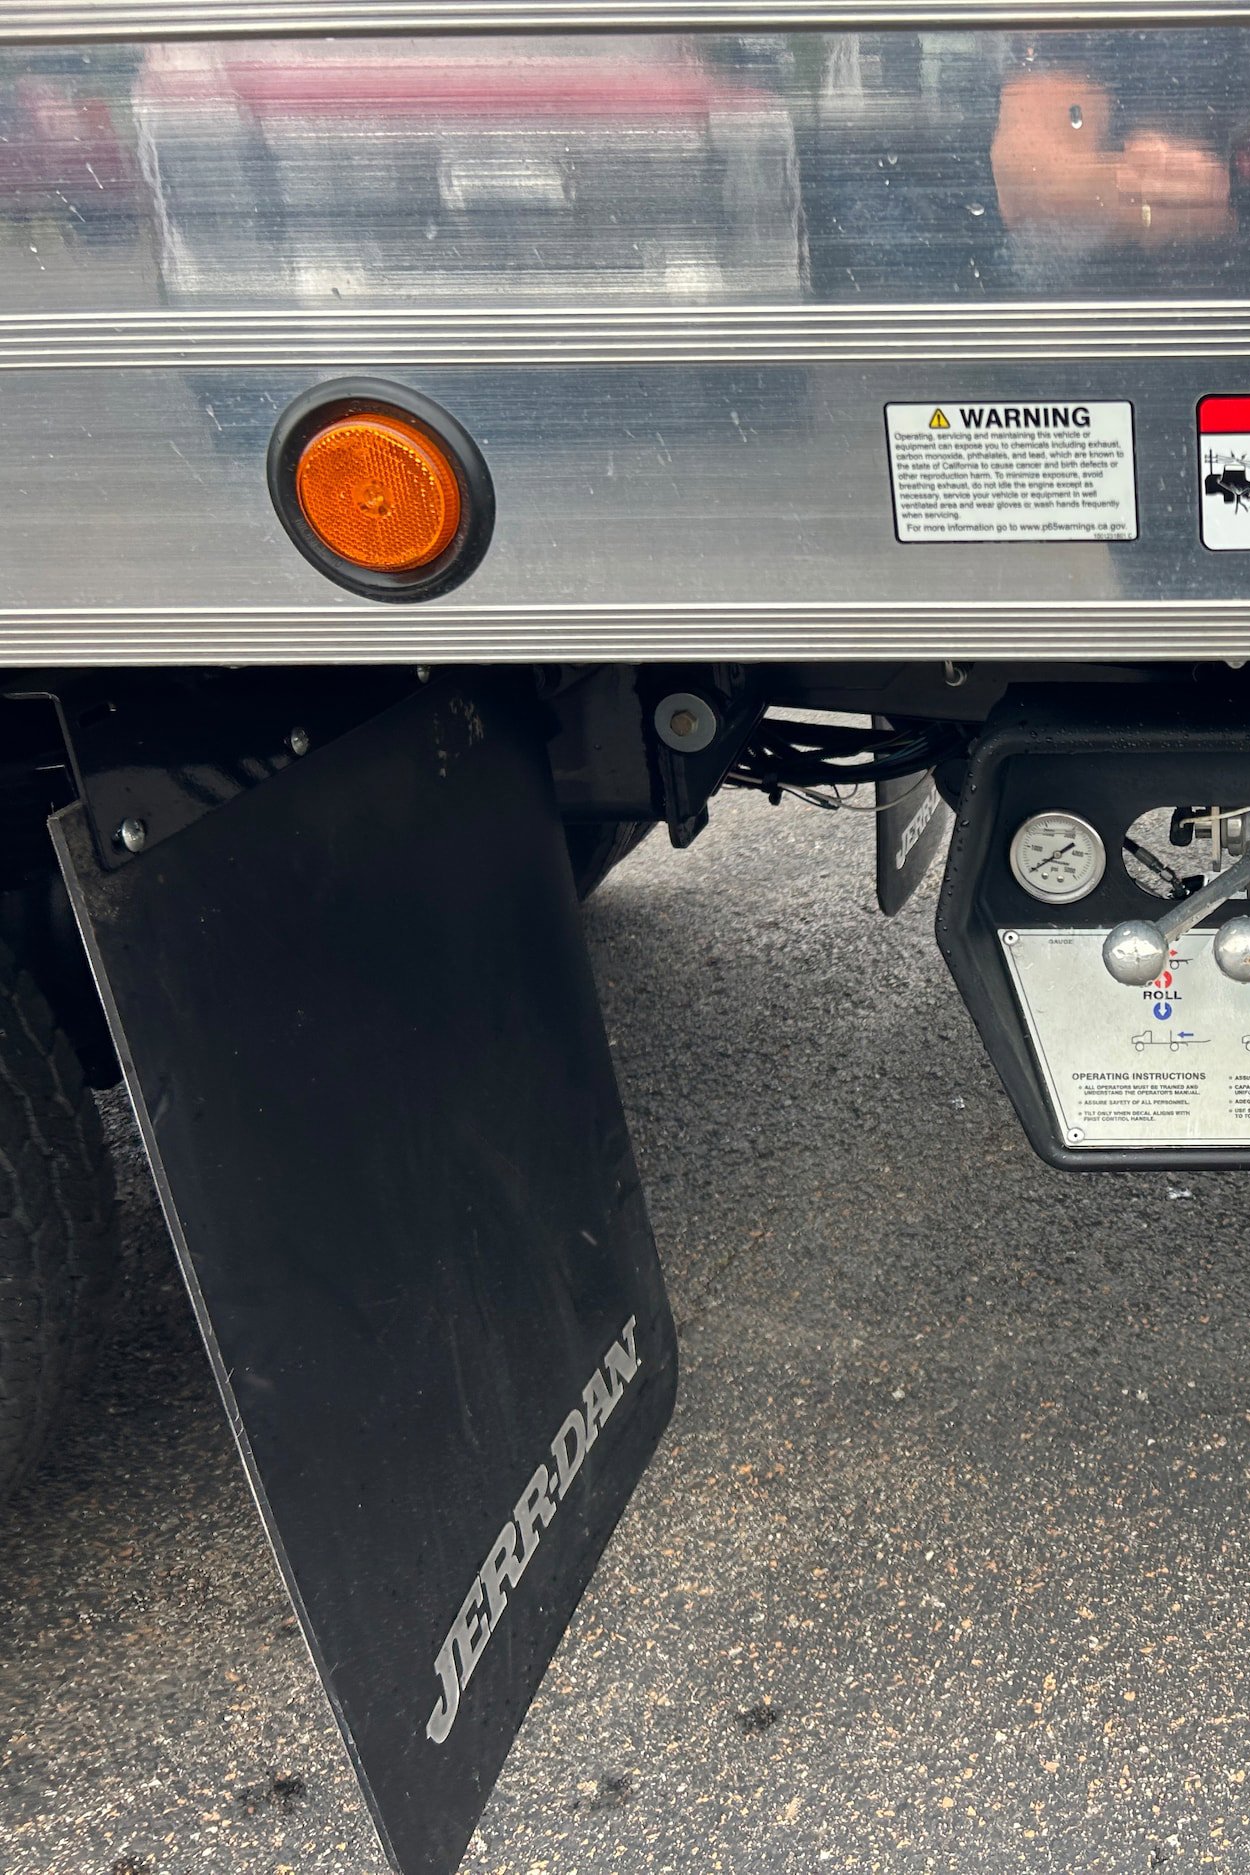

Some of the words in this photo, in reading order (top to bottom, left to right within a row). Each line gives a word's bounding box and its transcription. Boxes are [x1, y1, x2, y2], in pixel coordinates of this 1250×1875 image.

[960, 407, 1091, 428] WARNING
[894, 432, 935, 442] Operating,
[937, 432, 972, 442] servicing
[973, 432, 989, 440] and
[990, 431, 1036, 441] maintaining
[1036, 431, 1051, 439] this
[1053, 431, 1081, 439] vehicle
[895, 442, 936, 452] equipment
[954, 443, 983, 451] expose
[984, 443, 999, 451] you
[1001, 441, 1009, 449] to
[1010, 441, 1050, 449] chemicals
[1051, 441, 1087, 451] including
[1088, 441, 1121, 451] exhaust,
[897, 462, 910, 470] the
[911, 462, 931, 470] state
[942, 461, 979, 469] California
[981, 461, 989, 469] to
[1044, 461, 1059, 469] and
[1080, 460, 1108, 468] defects
[920, 471, 968, 481] reproduction
[970, 471, 992, 479] harm.
[994, 471, 1005, 479] To
[1006, 471, 1040, 479] minimize
[1042, 472, 1080, 480] exposure,
[1082, 470, 1104, 478] avoid
[898, 482, 936, 492] breathing
[937, 481, 970, 492] exhaust,
[971, 481, 983, 489] do
[983, 481, 997, 489] not
[998, 481, 1012, 489] idle
[1013, 481, 1026, 489] the
[1028, 481, 1055, 491] engine
[1056, 480, 1083, 490] except
[907, 524, 922, 532] For
[947, 524, 994, 532] information
[996, 525, 1008, 533] go
[1009, 523, 1018, 531] to
[1143, 990, 1182, 1000] ROLL
[1072, 1072, 1130, 1081] OPERATING
[1132, 1072, 1207, 1080] INSTRUCTIONS
[425, 1314, 638, 1745] JERR-DAN
